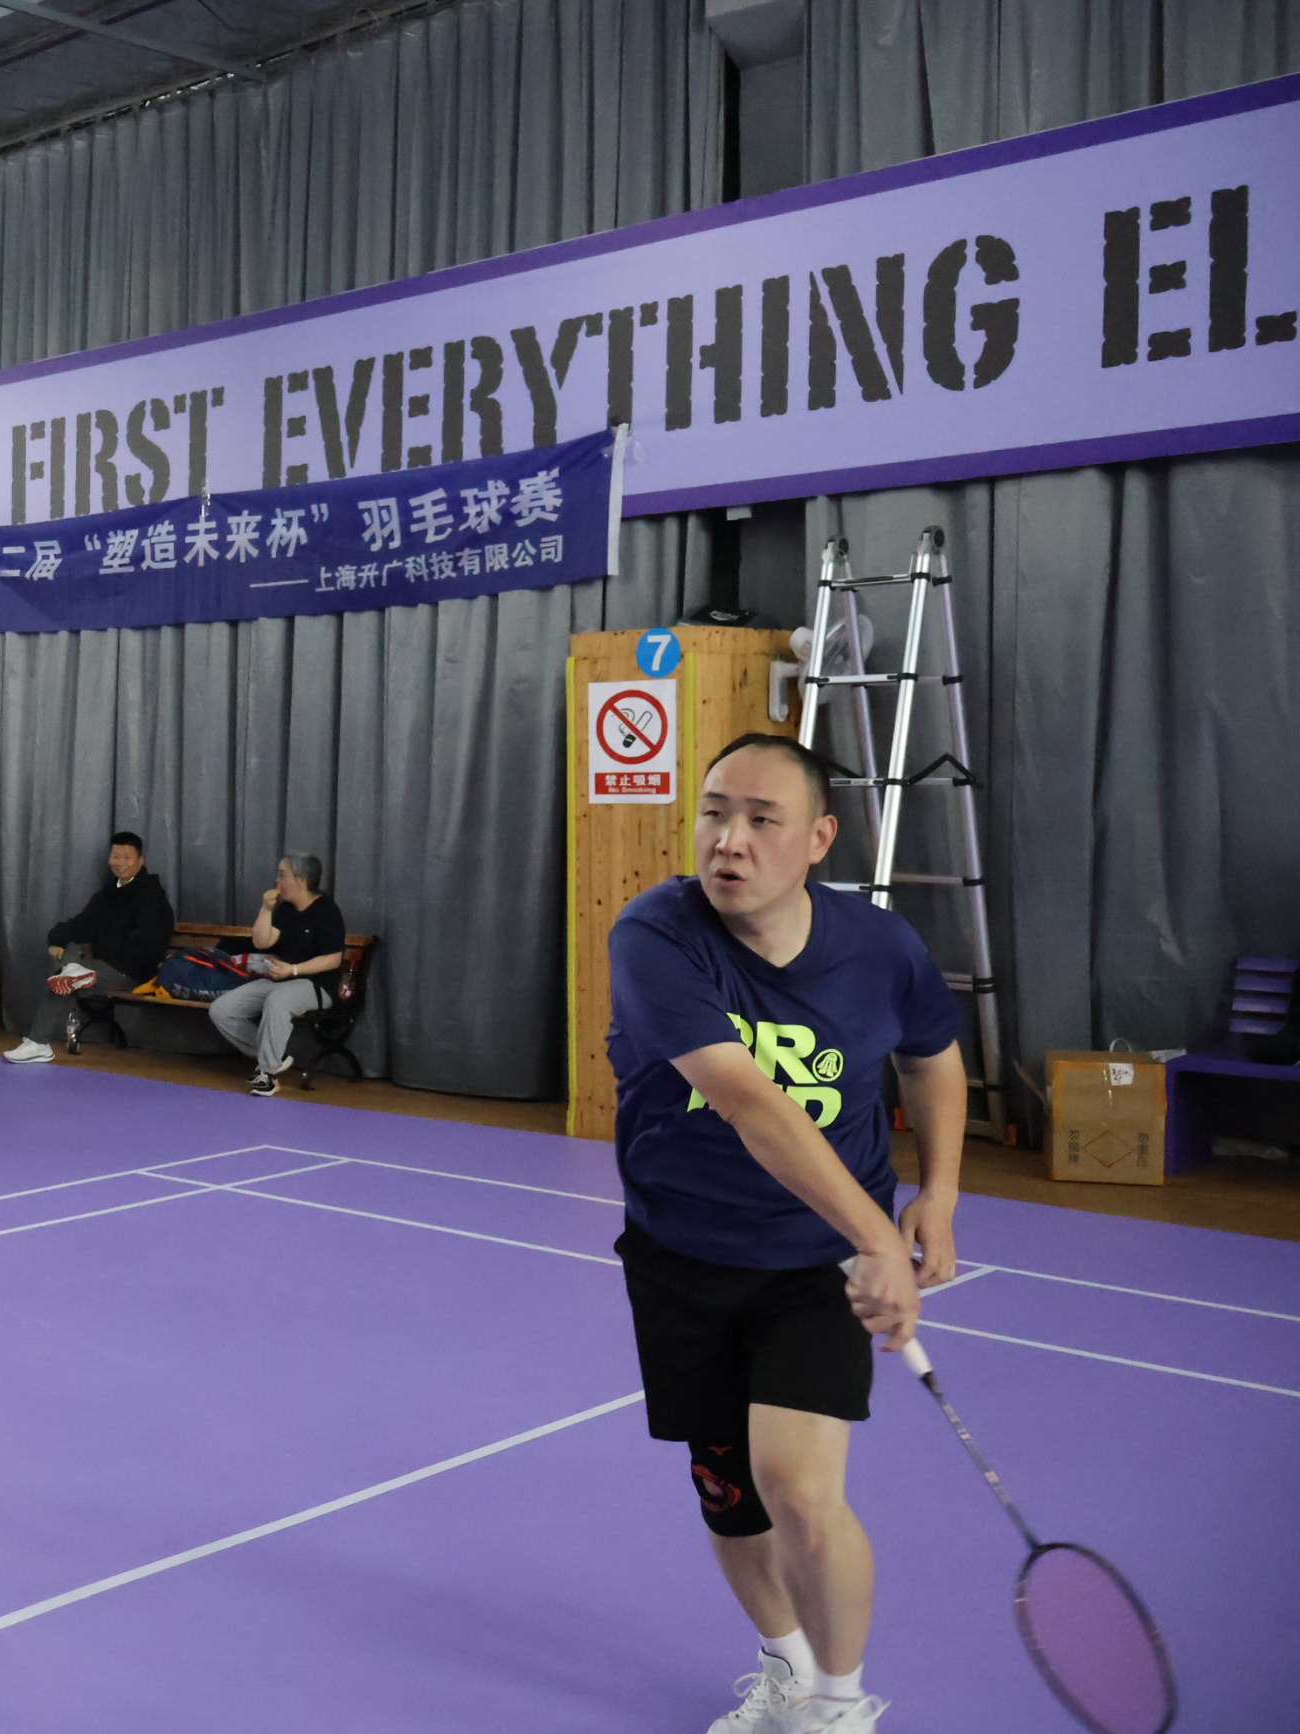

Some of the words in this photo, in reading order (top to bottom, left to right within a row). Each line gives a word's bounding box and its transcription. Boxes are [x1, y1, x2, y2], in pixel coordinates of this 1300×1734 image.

[11, 386, 224, 525] FIRST
[262, 234, 1020, 488] EVERYTHING
[1102, 184, 1297, 368] EL
[647, 635, 671, 671] 7
[605, 774, 661, 786] 禁止吸烟
